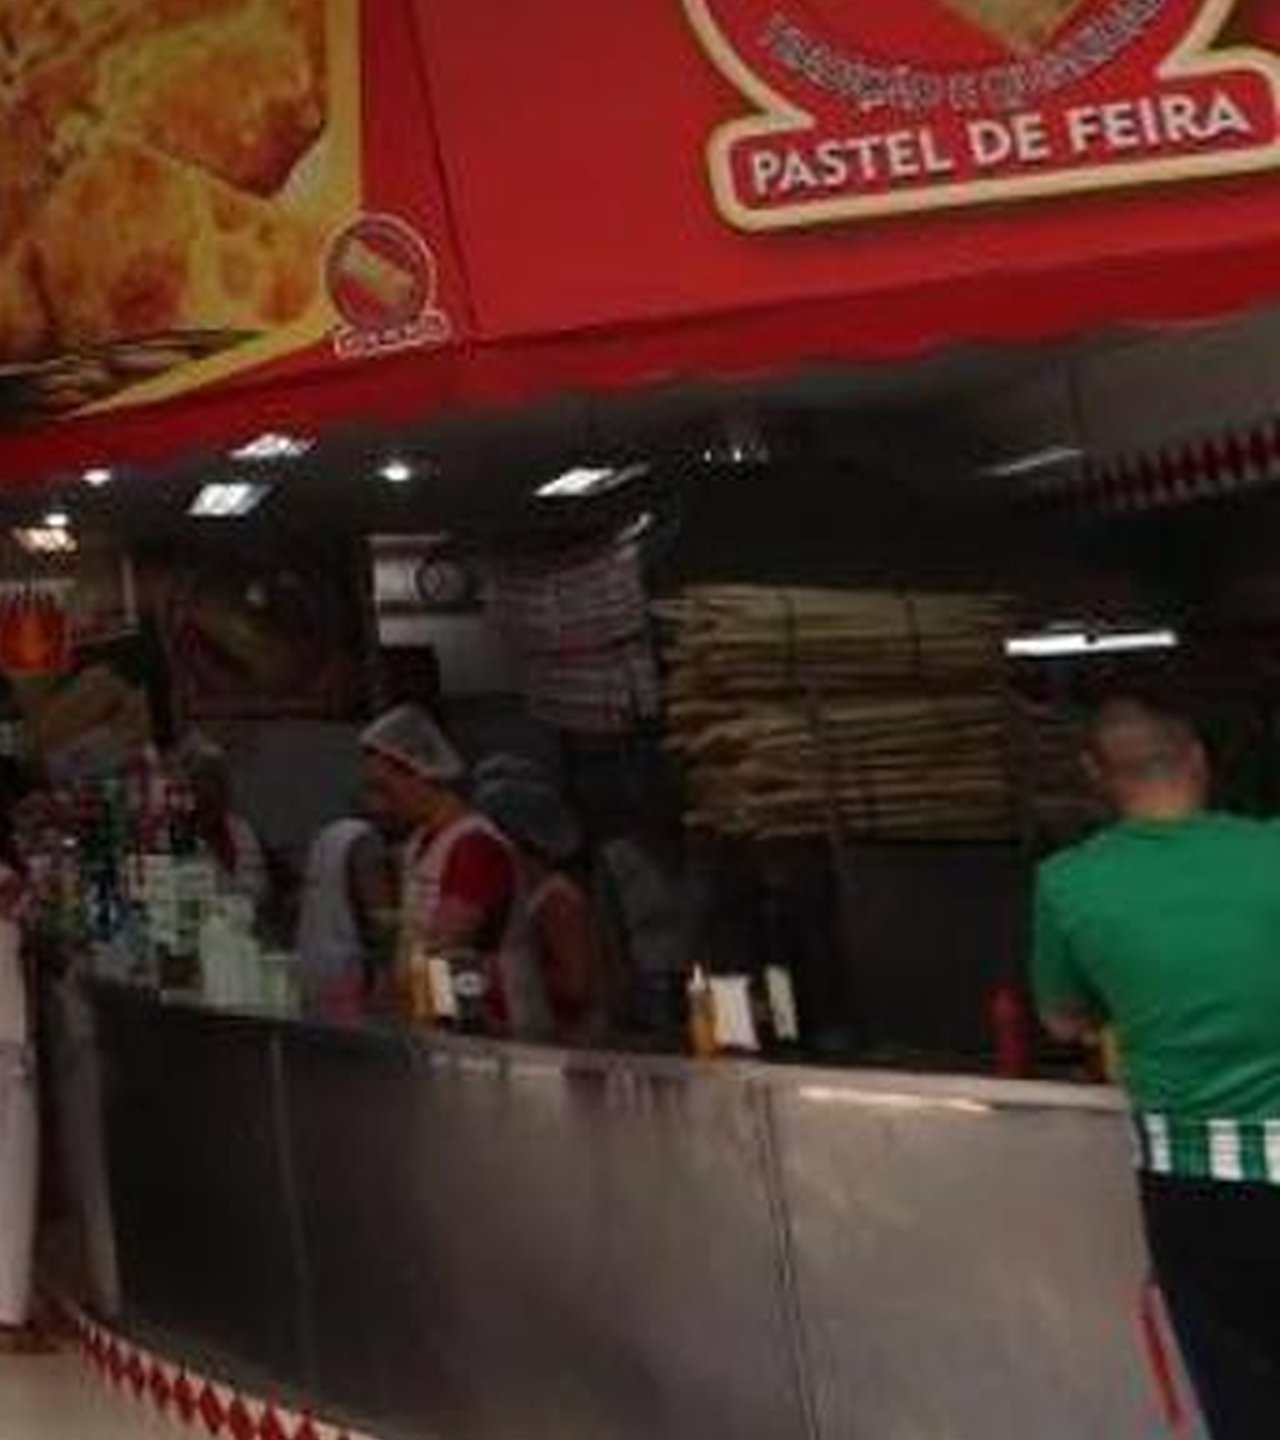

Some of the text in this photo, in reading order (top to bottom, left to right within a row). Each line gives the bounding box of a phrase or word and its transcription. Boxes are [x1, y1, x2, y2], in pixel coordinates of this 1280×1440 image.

[751, 94, 1251, 196] PASTEL DE FEIRA
